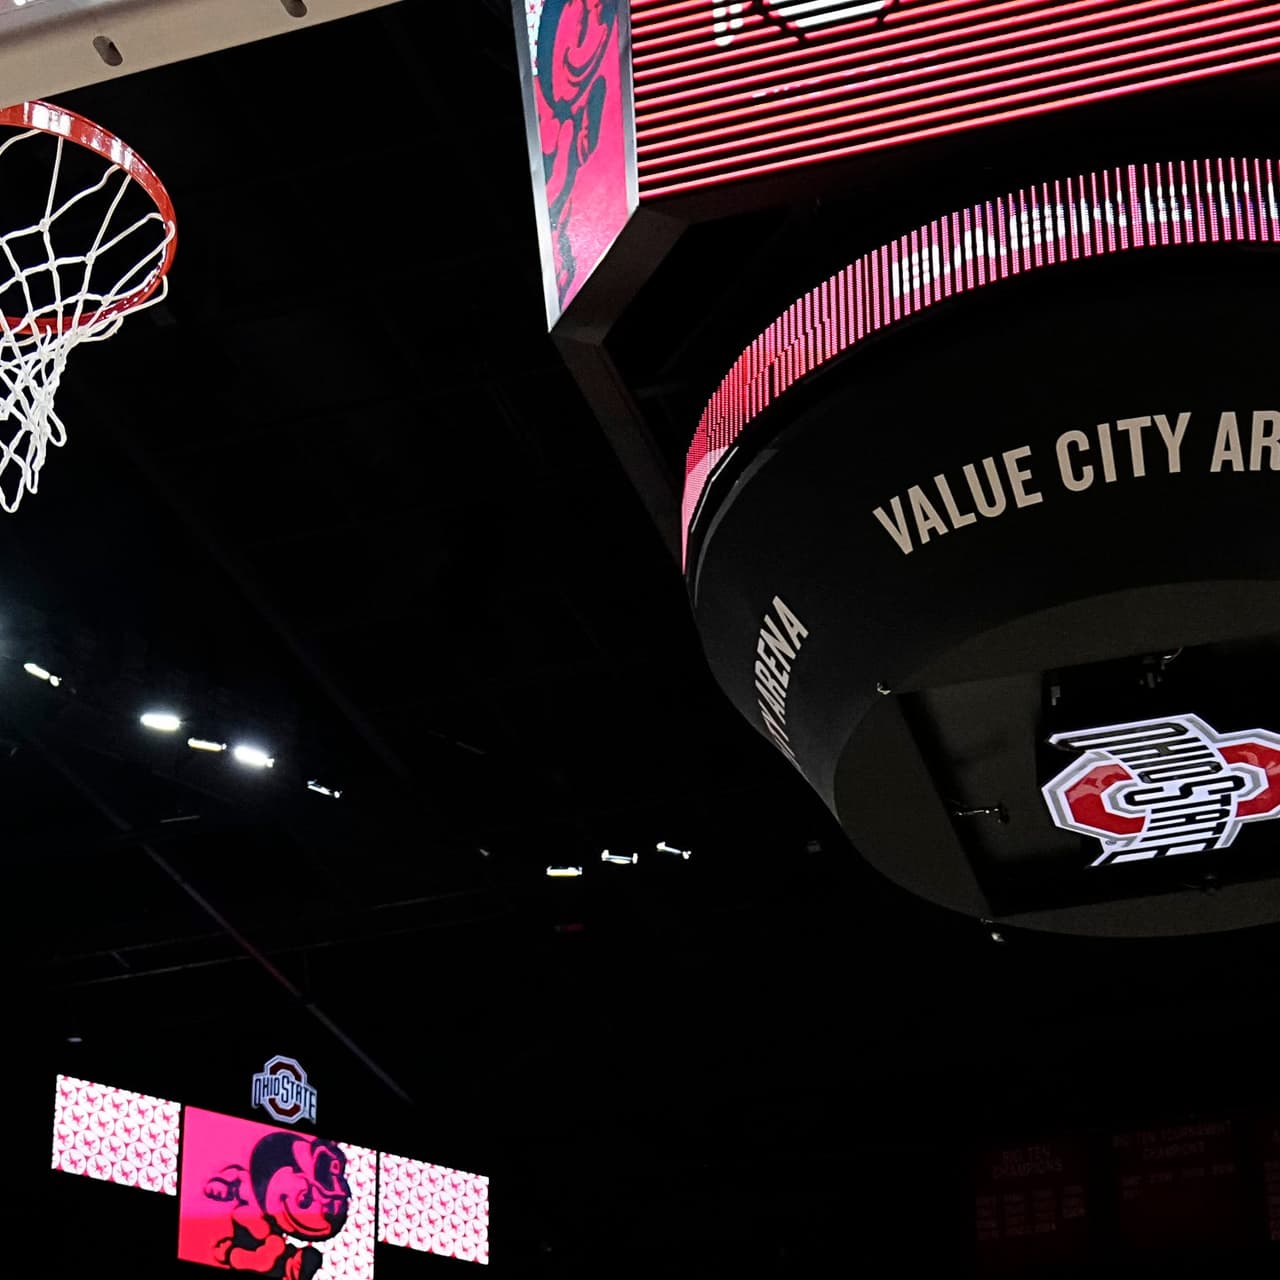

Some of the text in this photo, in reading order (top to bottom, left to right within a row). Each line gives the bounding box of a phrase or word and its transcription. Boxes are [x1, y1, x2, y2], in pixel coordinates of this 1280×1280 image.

[872, 446, 1043, 555] VALUE
[1056, 411, 1192, 492] CITY
[754, 595, 809, 725] ARENA
[254, 1075, 317, 1121] OHIO STATE
